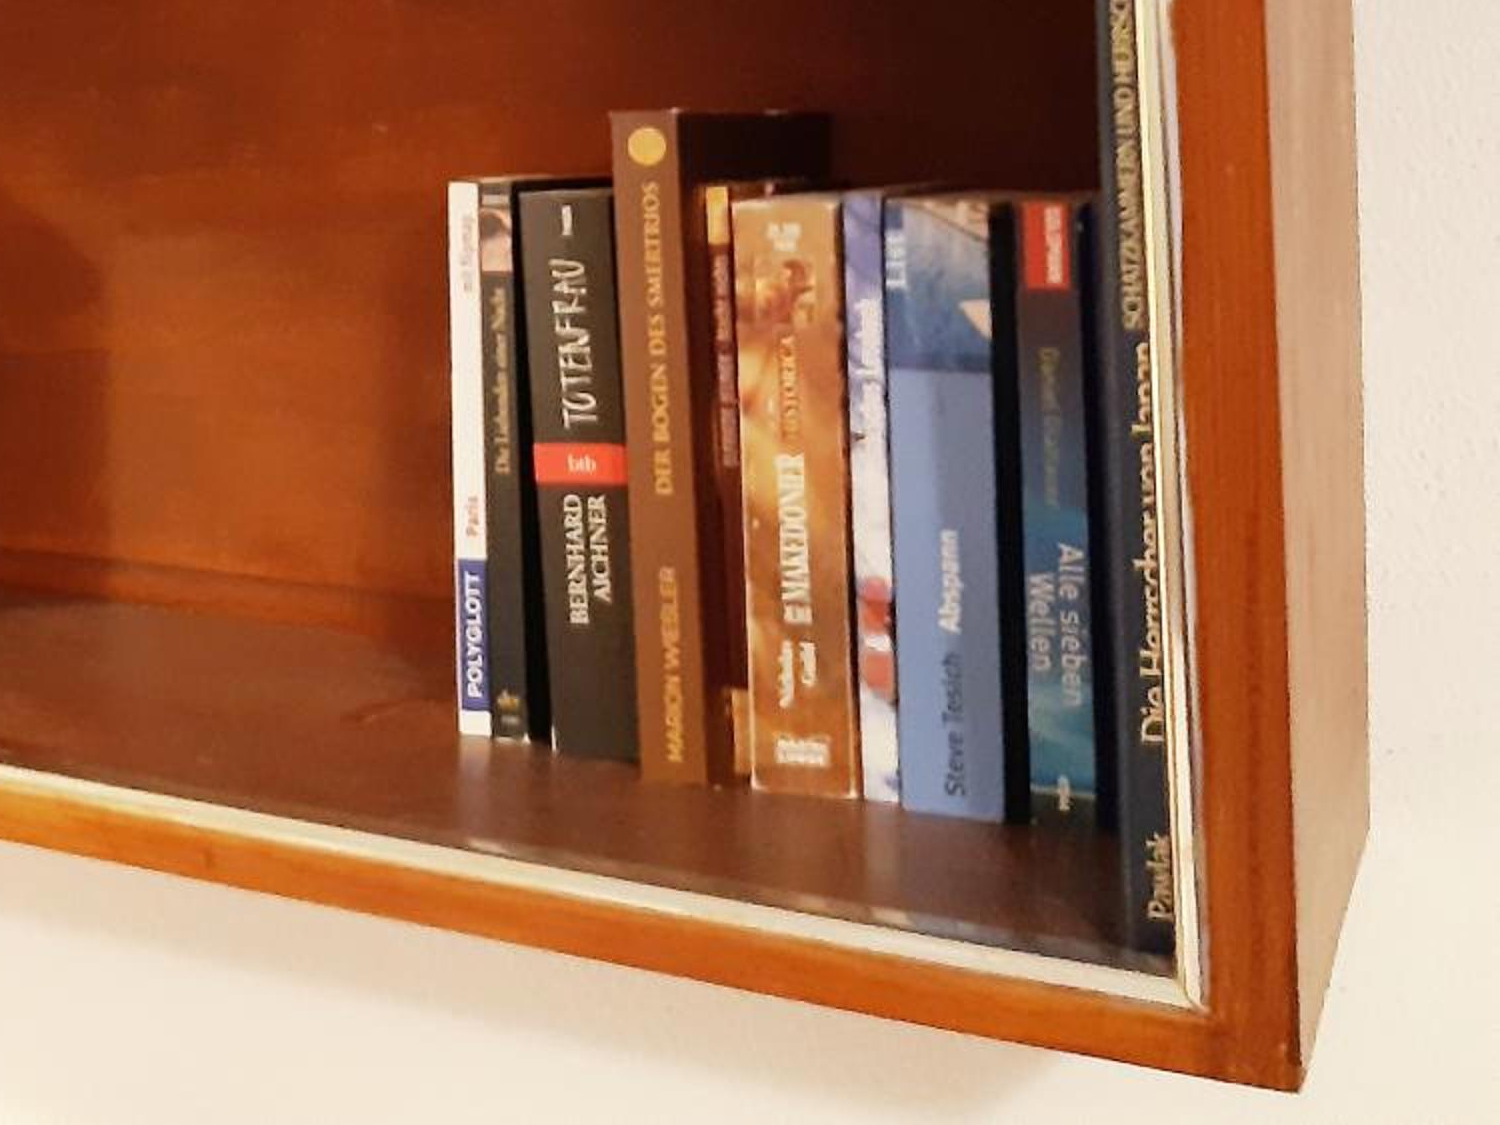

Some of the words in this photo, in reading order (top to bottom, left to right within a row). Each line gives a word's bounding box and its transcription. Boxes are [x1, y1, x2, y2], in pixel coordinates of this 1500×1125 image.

[1114, 87, 1137, 136] UND
[640, 180, 664, 309] SMERTRIOS
[1118, 141, 1144, 332] SCHATZKAMMERN
[550, 256, 600, 431] TOTENFRAU
[648, 314, 668, 357] DES
[650, 363, 672, 443] BOGEN
[777, 335, 802, 438] HISTORICA
[566, 452, 598, 475] btb
[654, 450, 674, 494] DER
[465, 495, 480, 539] Paris
[564, 493, 592, 626] BERNHARD
[586, 493, 612, 603] AICHNER
[777, 452, 810, 605] MAKEDONIER
[938, 528, 964, 636] Abspann
[1056, 542, 1087, 602] Alle
[1132, 509, 1163, 679] Herrscher
[464, 569, 488, 700] POLYGLOTT
[1026, 574, 1054, 672] Wellen
[1058, 609, 1088, 707] sieben
[664, 674, 684, 763] MARION
[943, 651, 965, 724] Tesich
[1140, 685, 1165, 744] Die
[944, 731, 966, 797] Steve
[1145, 830, 1174, 922] Pawlak
